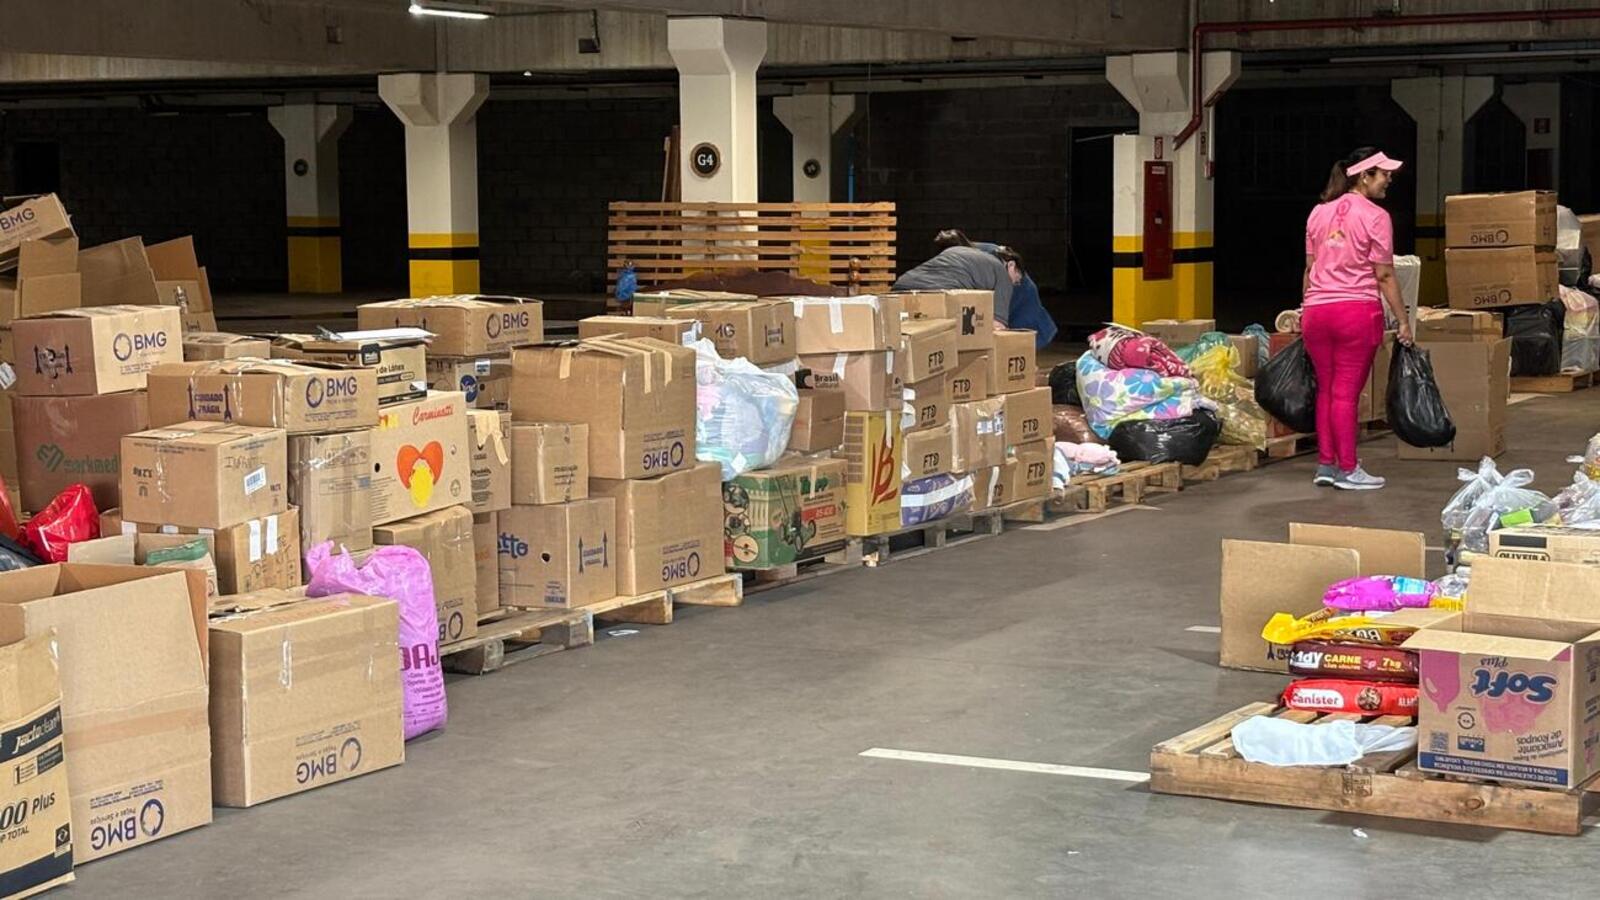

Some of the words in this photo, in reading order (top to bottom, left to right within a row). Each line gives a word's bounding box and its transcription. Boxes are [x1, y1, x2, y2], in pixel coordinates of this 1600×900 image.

[697, 153, 714, 166] G4
[1, 207, 35, 230] BMG
[1471, 234, 1495, 244] BMG
[1474, 295, 1497, 305] BMG
[502, 311, 529, 330] BMG
[133, 331, 167, 350] BMG
[928, 350, 944, 368] FTD
[1008, 356, 1026, 374] FTD
[814, 372, 839, 382] Brasil
[953, 379, 971, 393] FTD
[326, 376, 358, 397] BMG
[921, 404, 936, 421] FTD
[1022, 418, 1039, 433] FTD
[643, 451, 668, 470] BMG
[923, 452, 939, 469] FTD
[1027, 461, 1046, 479] FTD
[662, 562, 686, 582] BMG
[1324, 653, 1362, 665] CARNE
[1480, 656, 1508, 669] Plus
[1471, 669, 1557, 703] Soft
[1293, 691, 1339, 705] Canister
[296, 753, 337, 784] BMG
[32, 792, 55, 815] Plus
[8, 826, 29, 840] TOTAL
[91, 816, 136, 850] BMG
